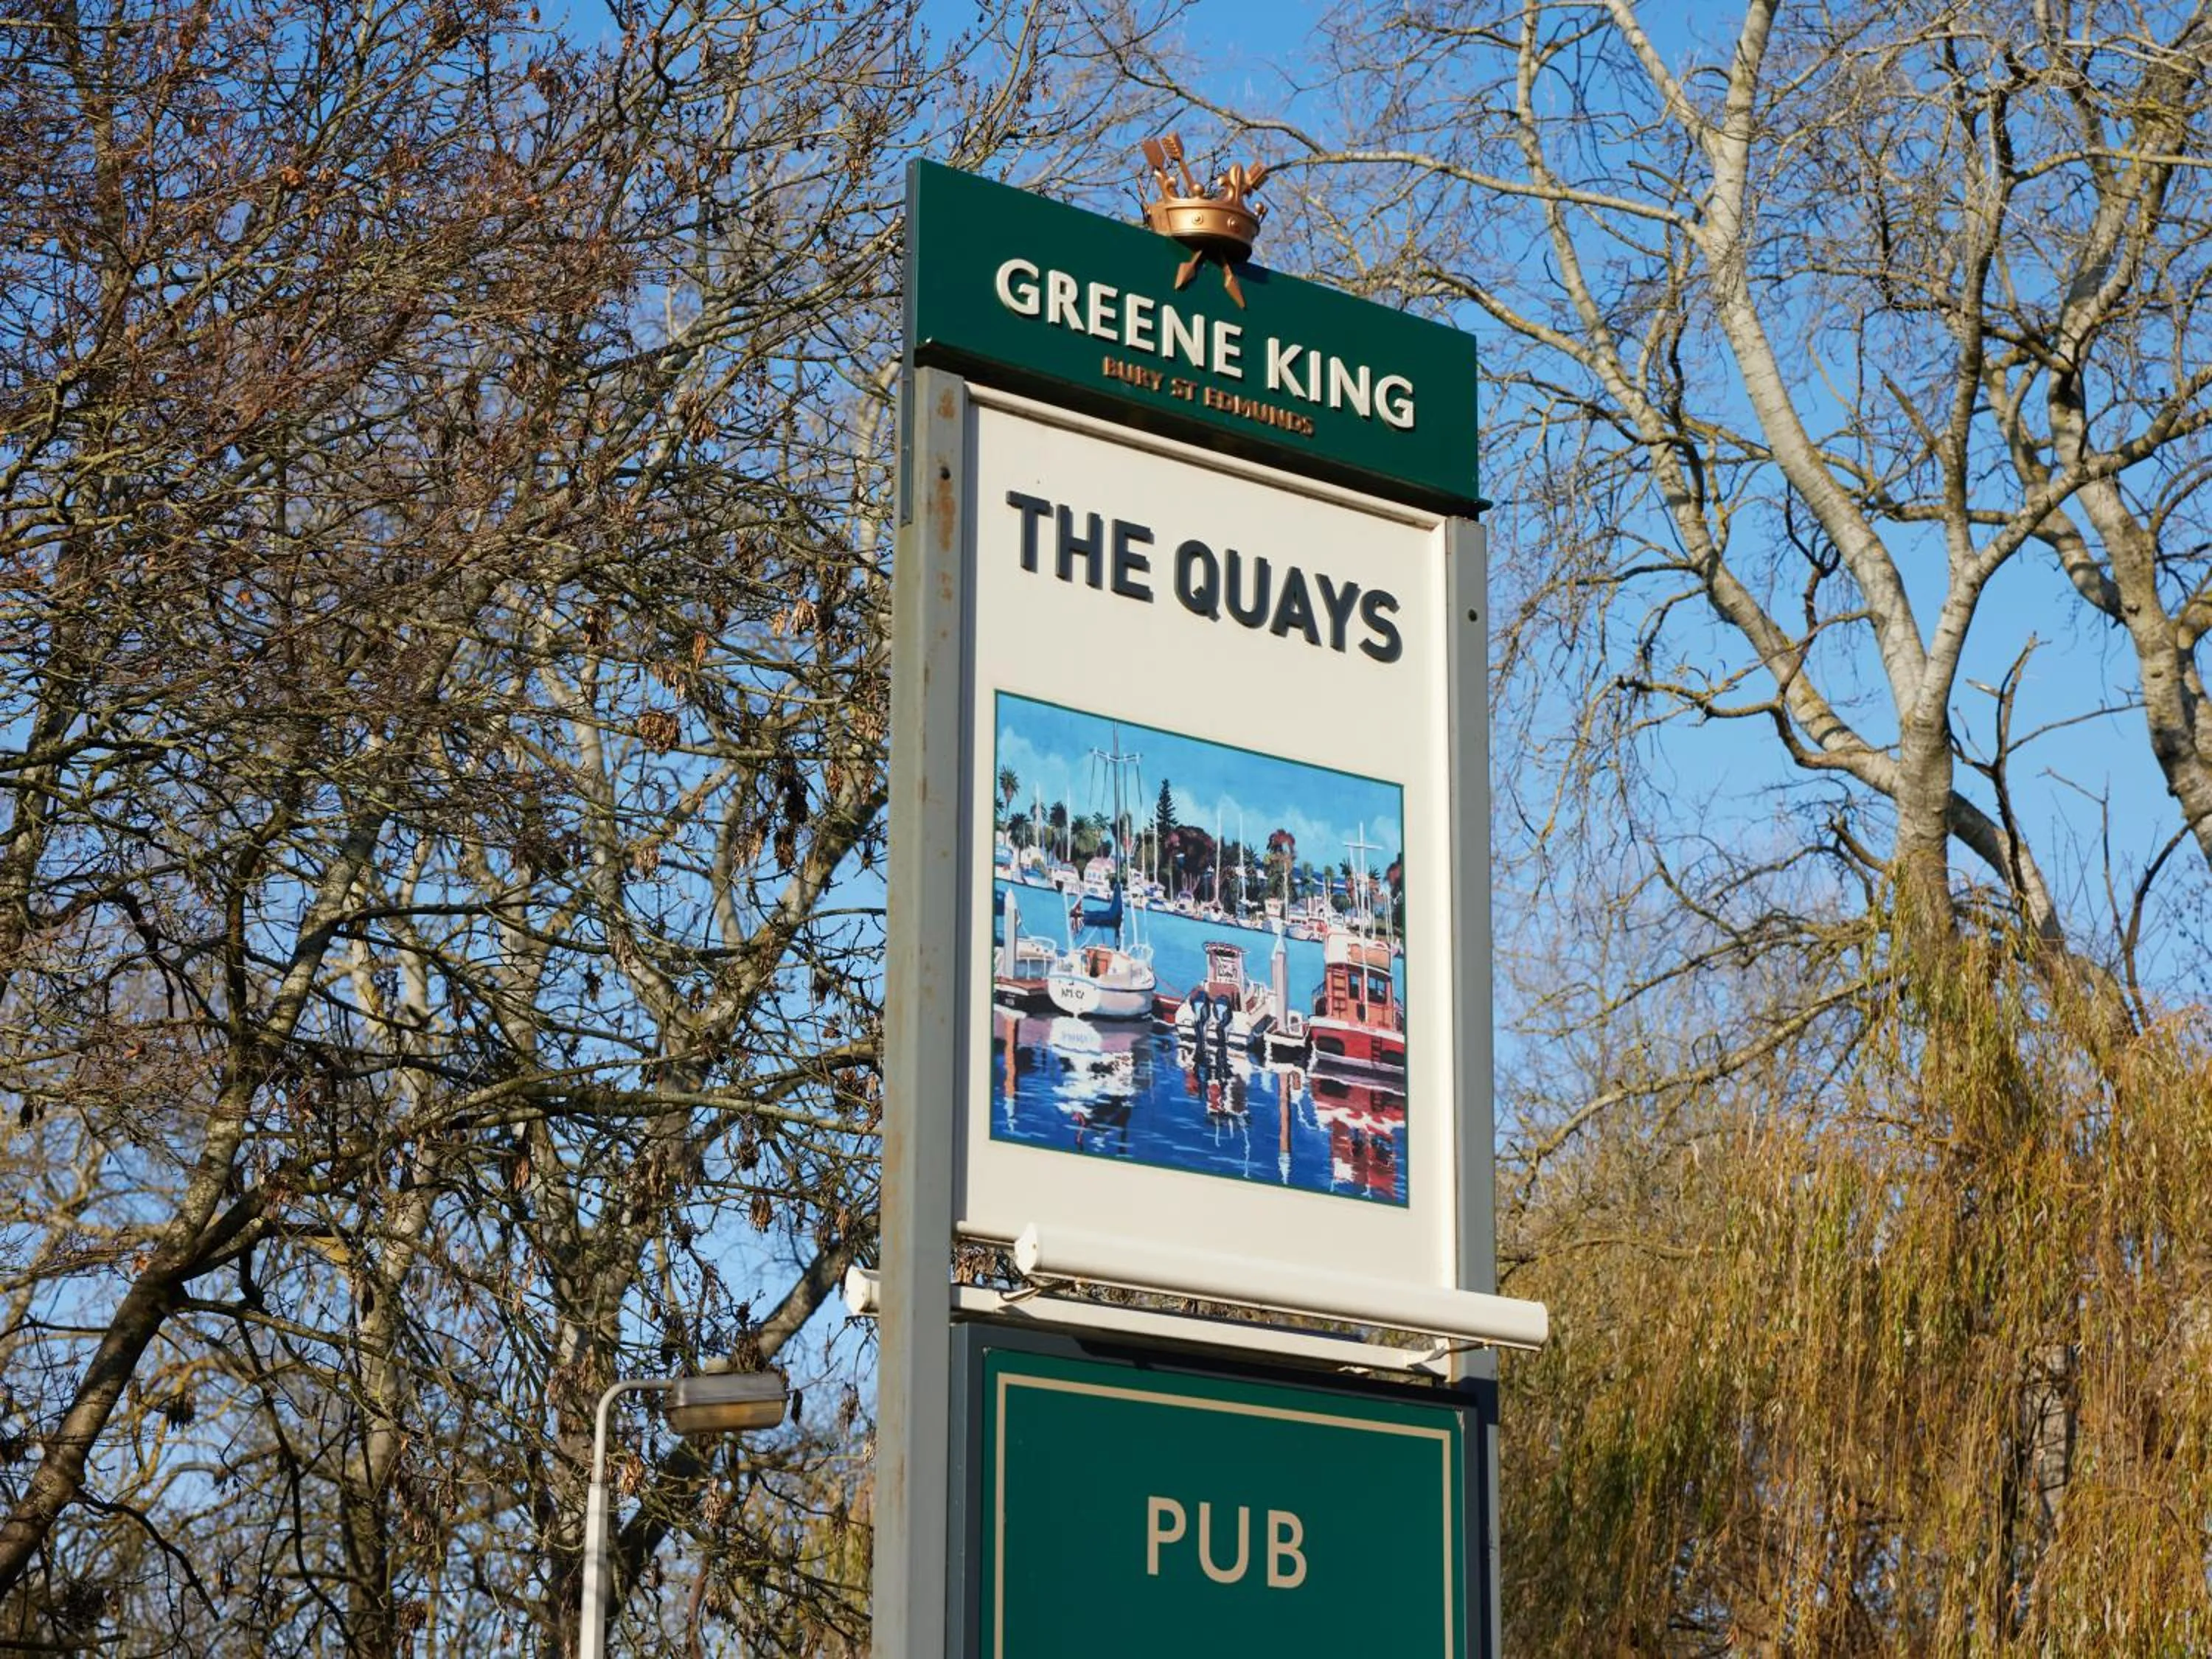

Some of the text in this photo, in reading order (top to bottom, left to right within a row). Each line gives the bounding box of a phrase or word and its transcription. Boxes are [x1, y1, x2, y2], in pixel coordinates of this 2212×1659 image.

[995, 258, 1416, 431] GREENE KING
[1102, 355, 1315, 437] BURY ST EDMUNDS
[1006, 490, 1402, 664] THE QUAYS
[1147, 1495, 1308, 1589] PUB
